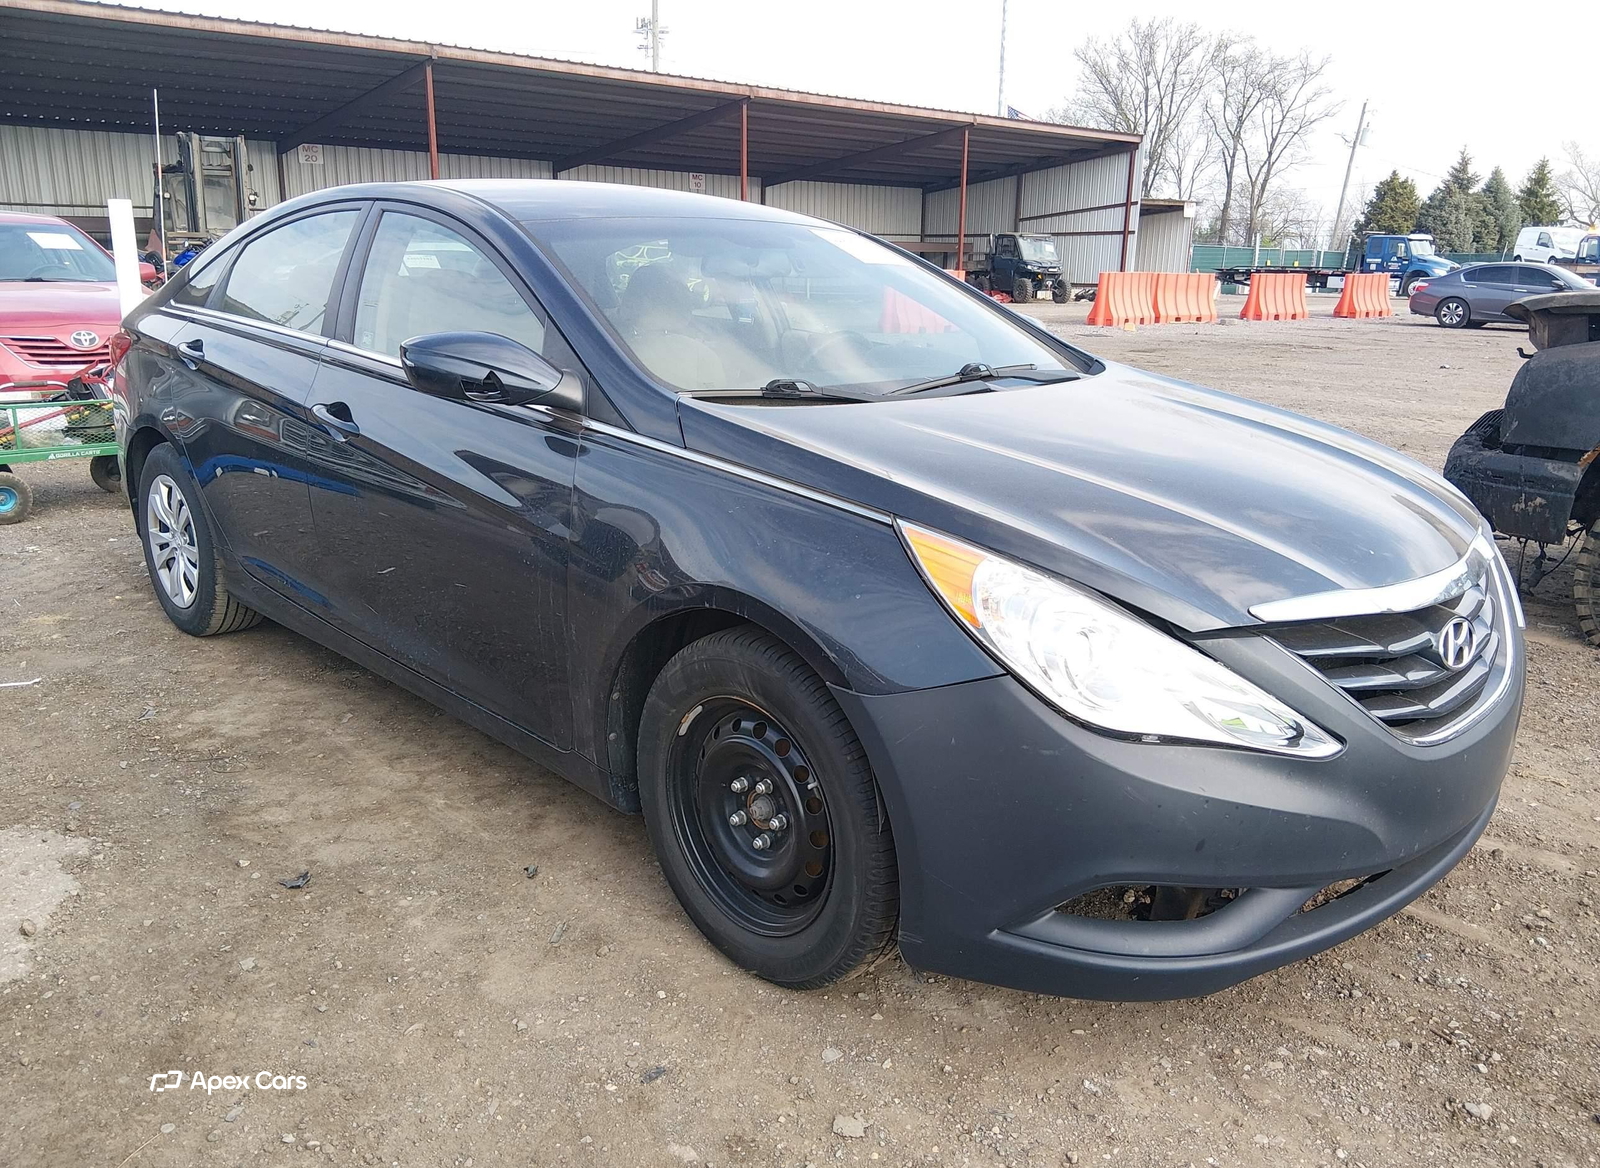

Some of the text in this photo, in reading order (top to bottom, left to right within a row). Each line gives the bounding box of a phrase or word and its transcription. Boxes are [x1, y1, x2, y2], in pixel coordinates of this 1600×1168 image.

[302, 145, 318, 153] MC
[304, 154, 318, 162] 20
[691, 173, 703, 181] MC
